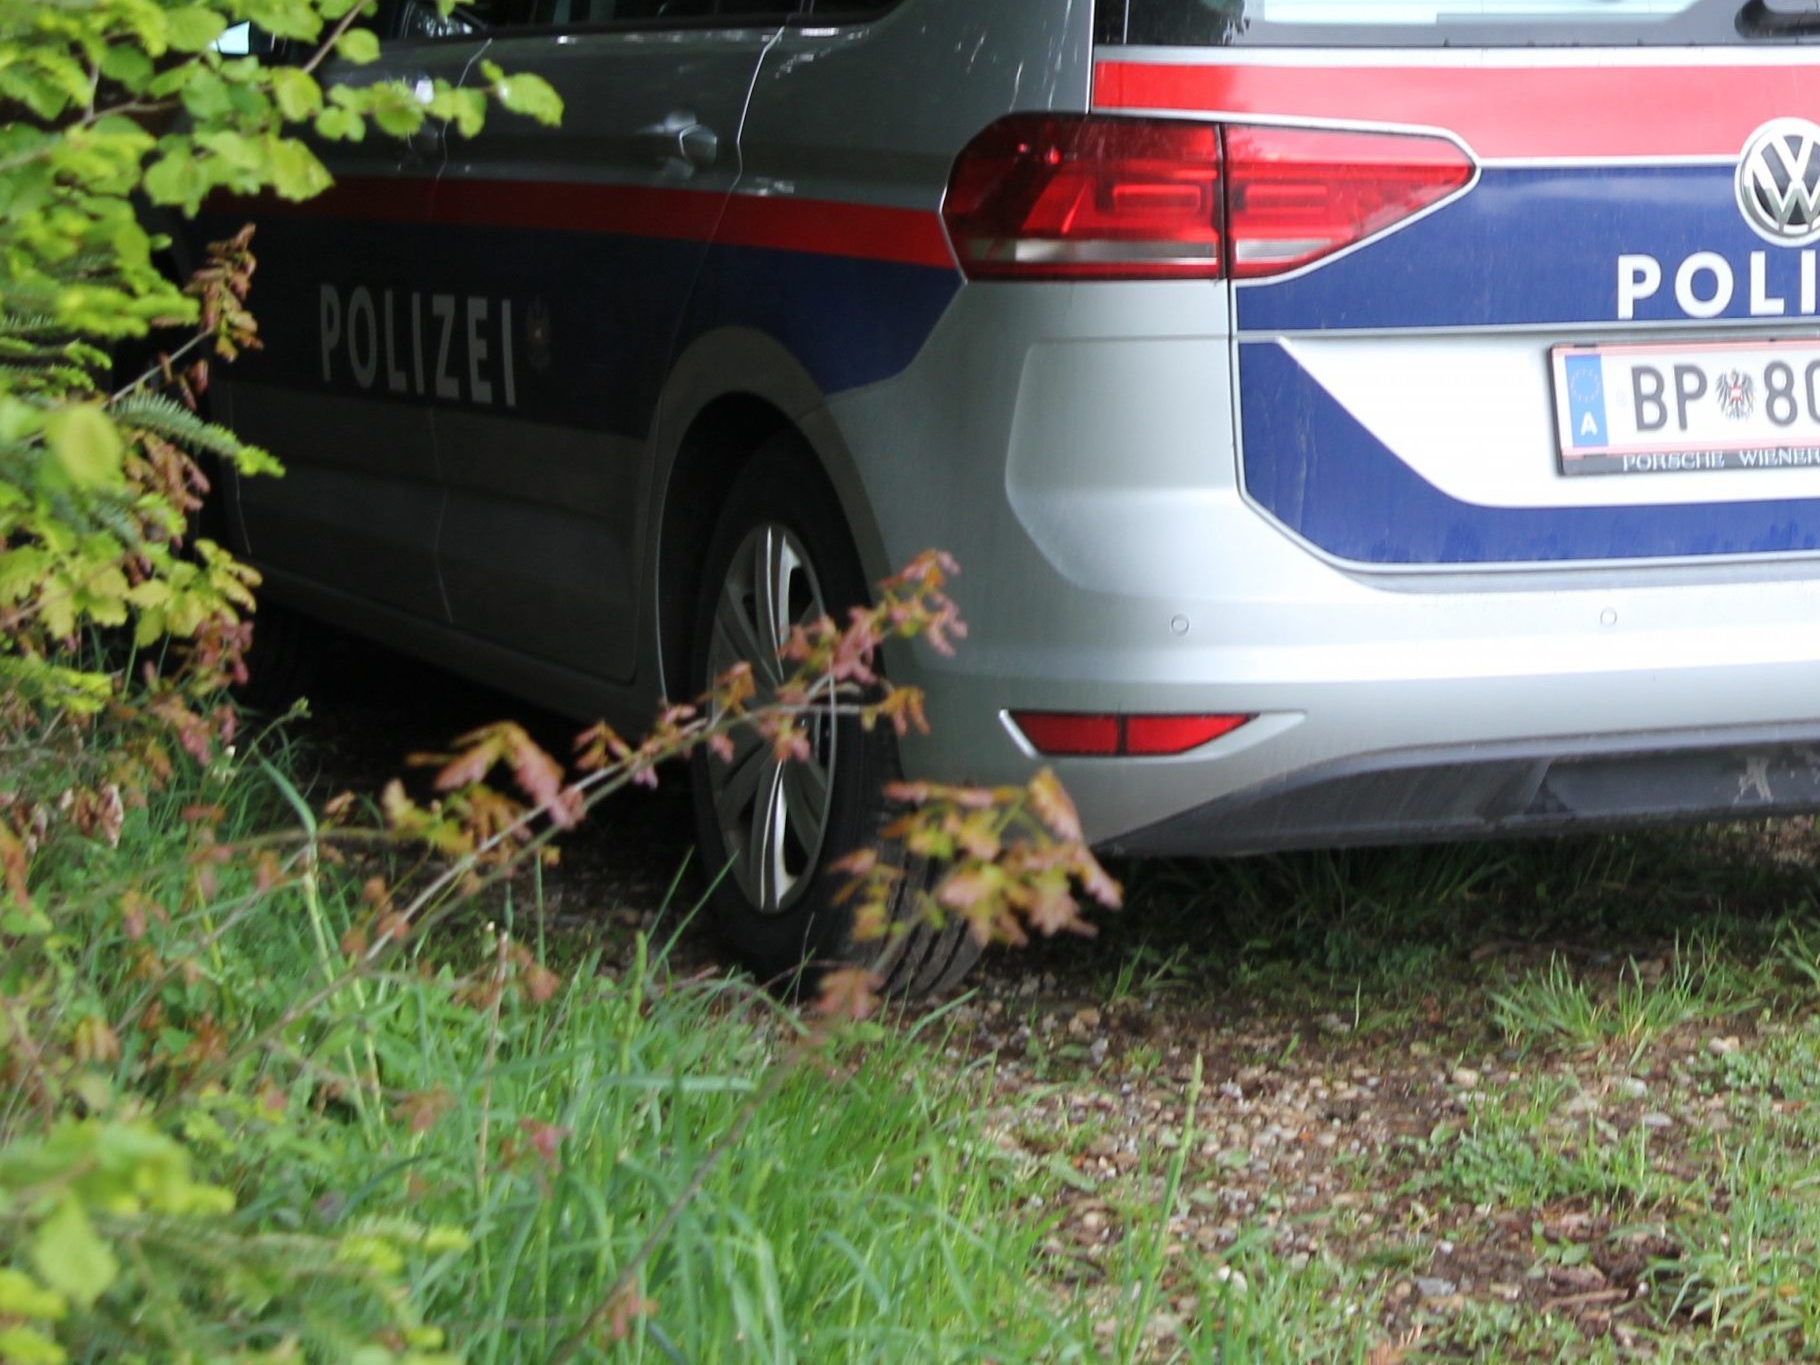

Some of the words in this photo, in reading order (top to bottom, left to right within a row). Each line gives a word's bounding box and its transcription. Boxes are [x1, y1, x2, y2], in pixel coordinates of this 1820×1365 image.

[319, 282, 517, 408] POLIZEI
[1629, 362, 1708, 433] BP
[1580, 411, 1599, 437] A
[1622, 449, 1726, 472] PORSCHE
